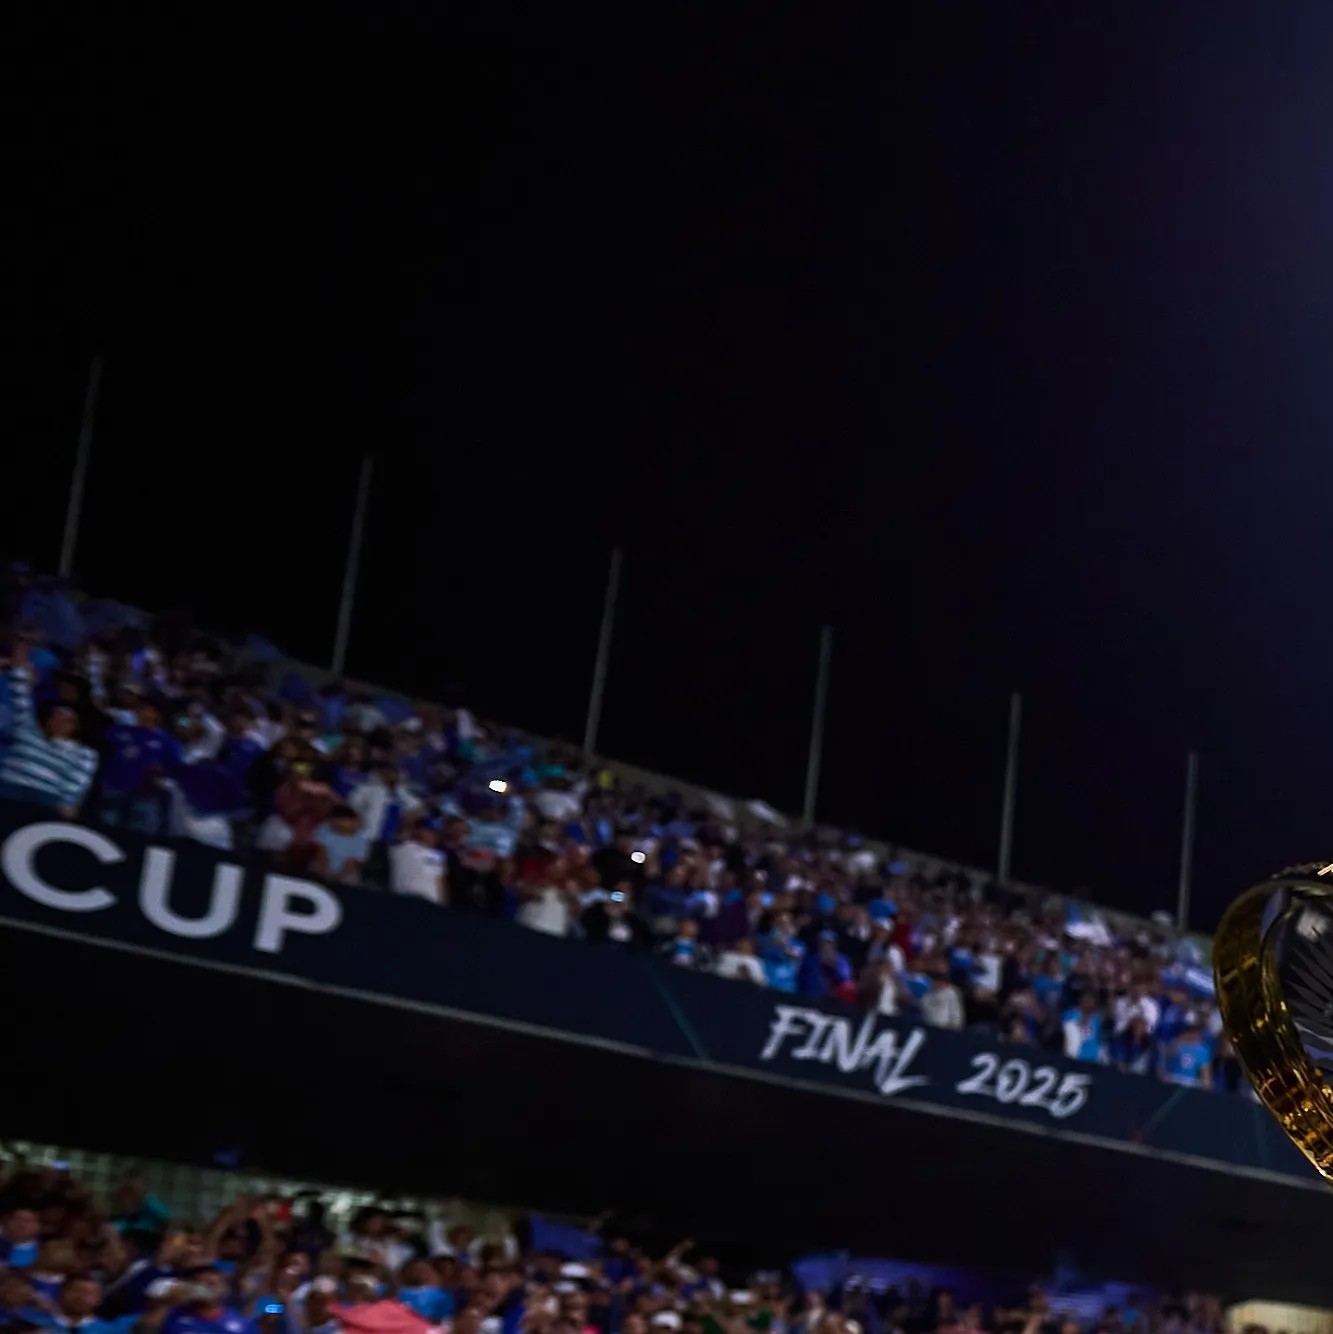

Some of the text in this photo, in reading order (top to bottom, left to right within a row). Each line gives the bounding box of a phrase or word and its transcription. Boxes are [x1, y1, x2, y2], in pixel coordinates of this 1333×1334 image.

[2, 821, 343, 953] CUP
[759, 1004, 1092, 1118] FINAL 2025
